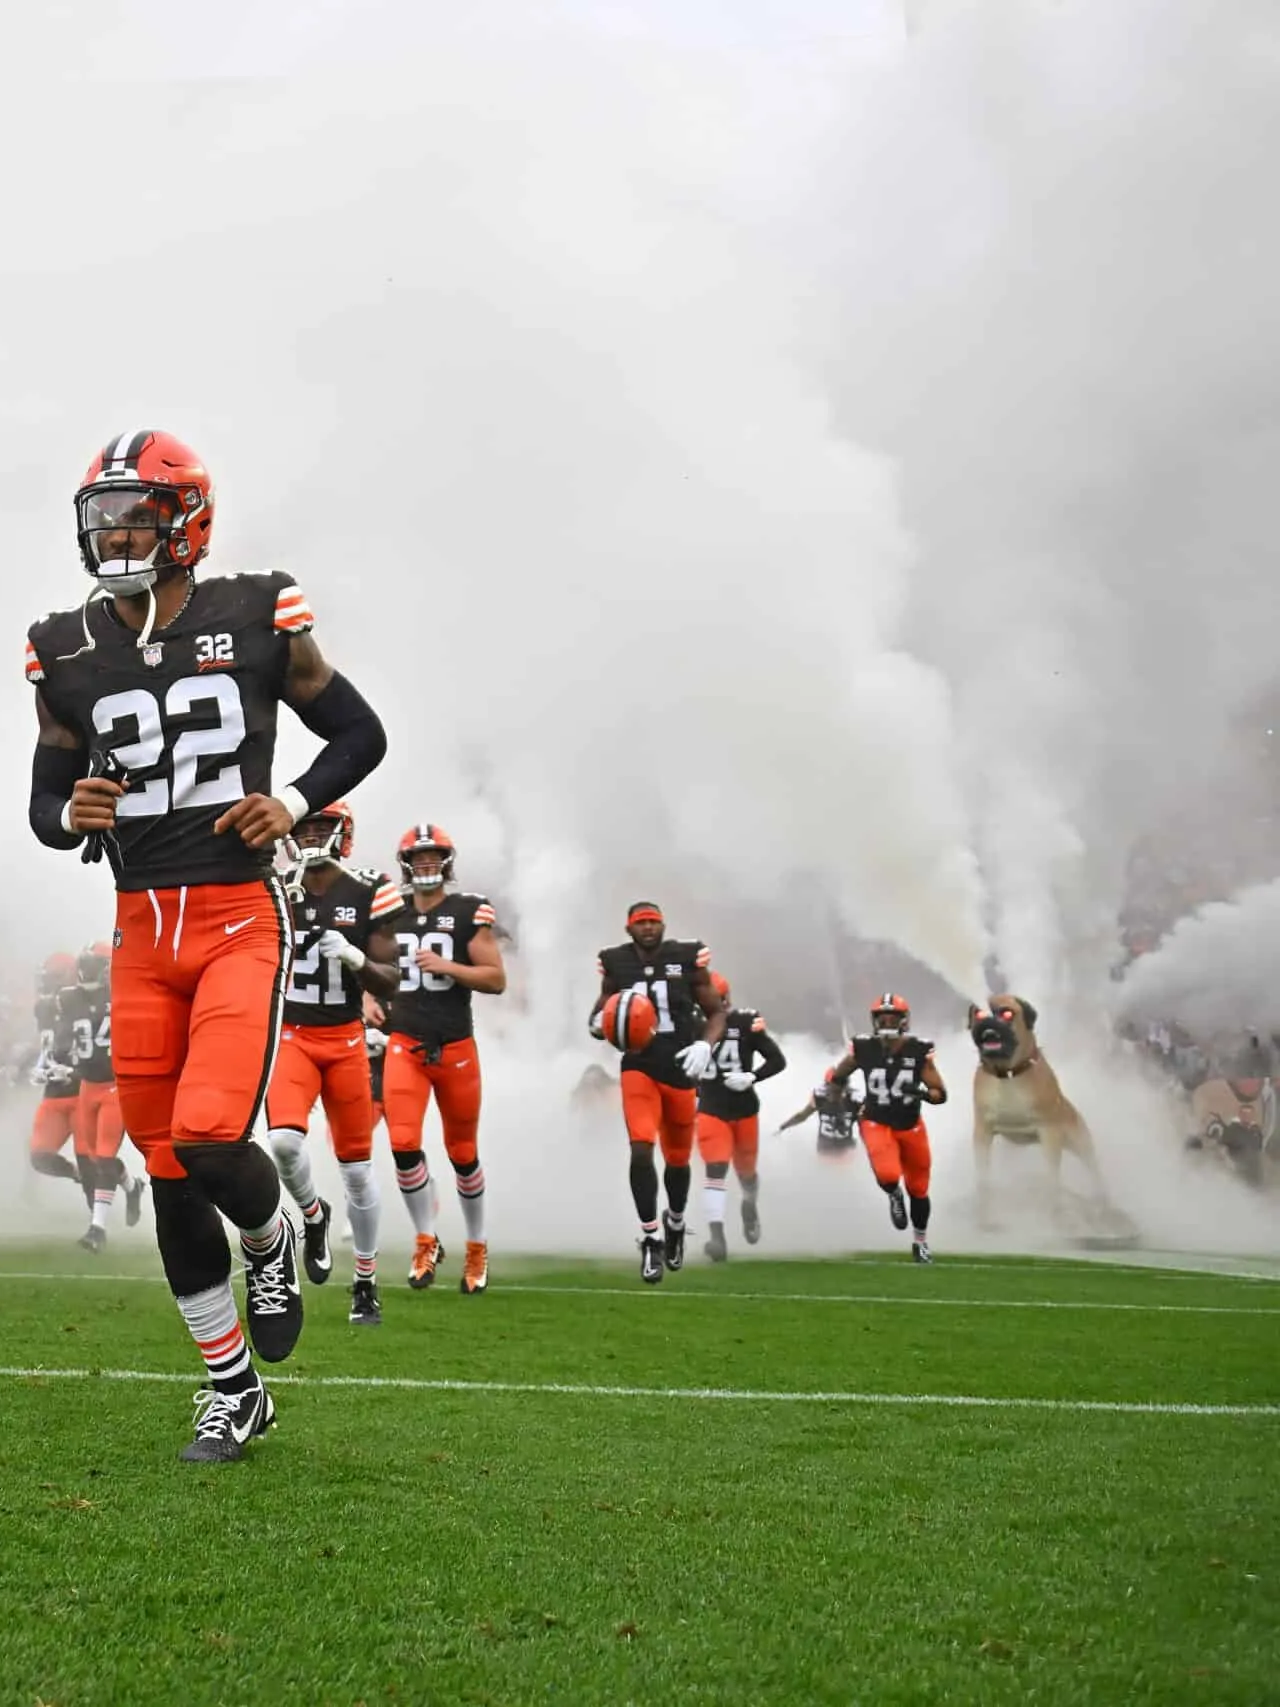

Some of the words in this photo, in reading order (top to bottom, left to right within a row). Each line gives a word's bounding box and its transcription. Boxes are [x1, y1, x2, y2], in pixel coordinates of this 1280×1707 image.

[195, 633, 234, 662] 32
[92, 673, 246, 817] 22
[334, 907, 357, 922] 32
[436, 916, 455, 929] 32
[286, 930, 346, 1005] 21
